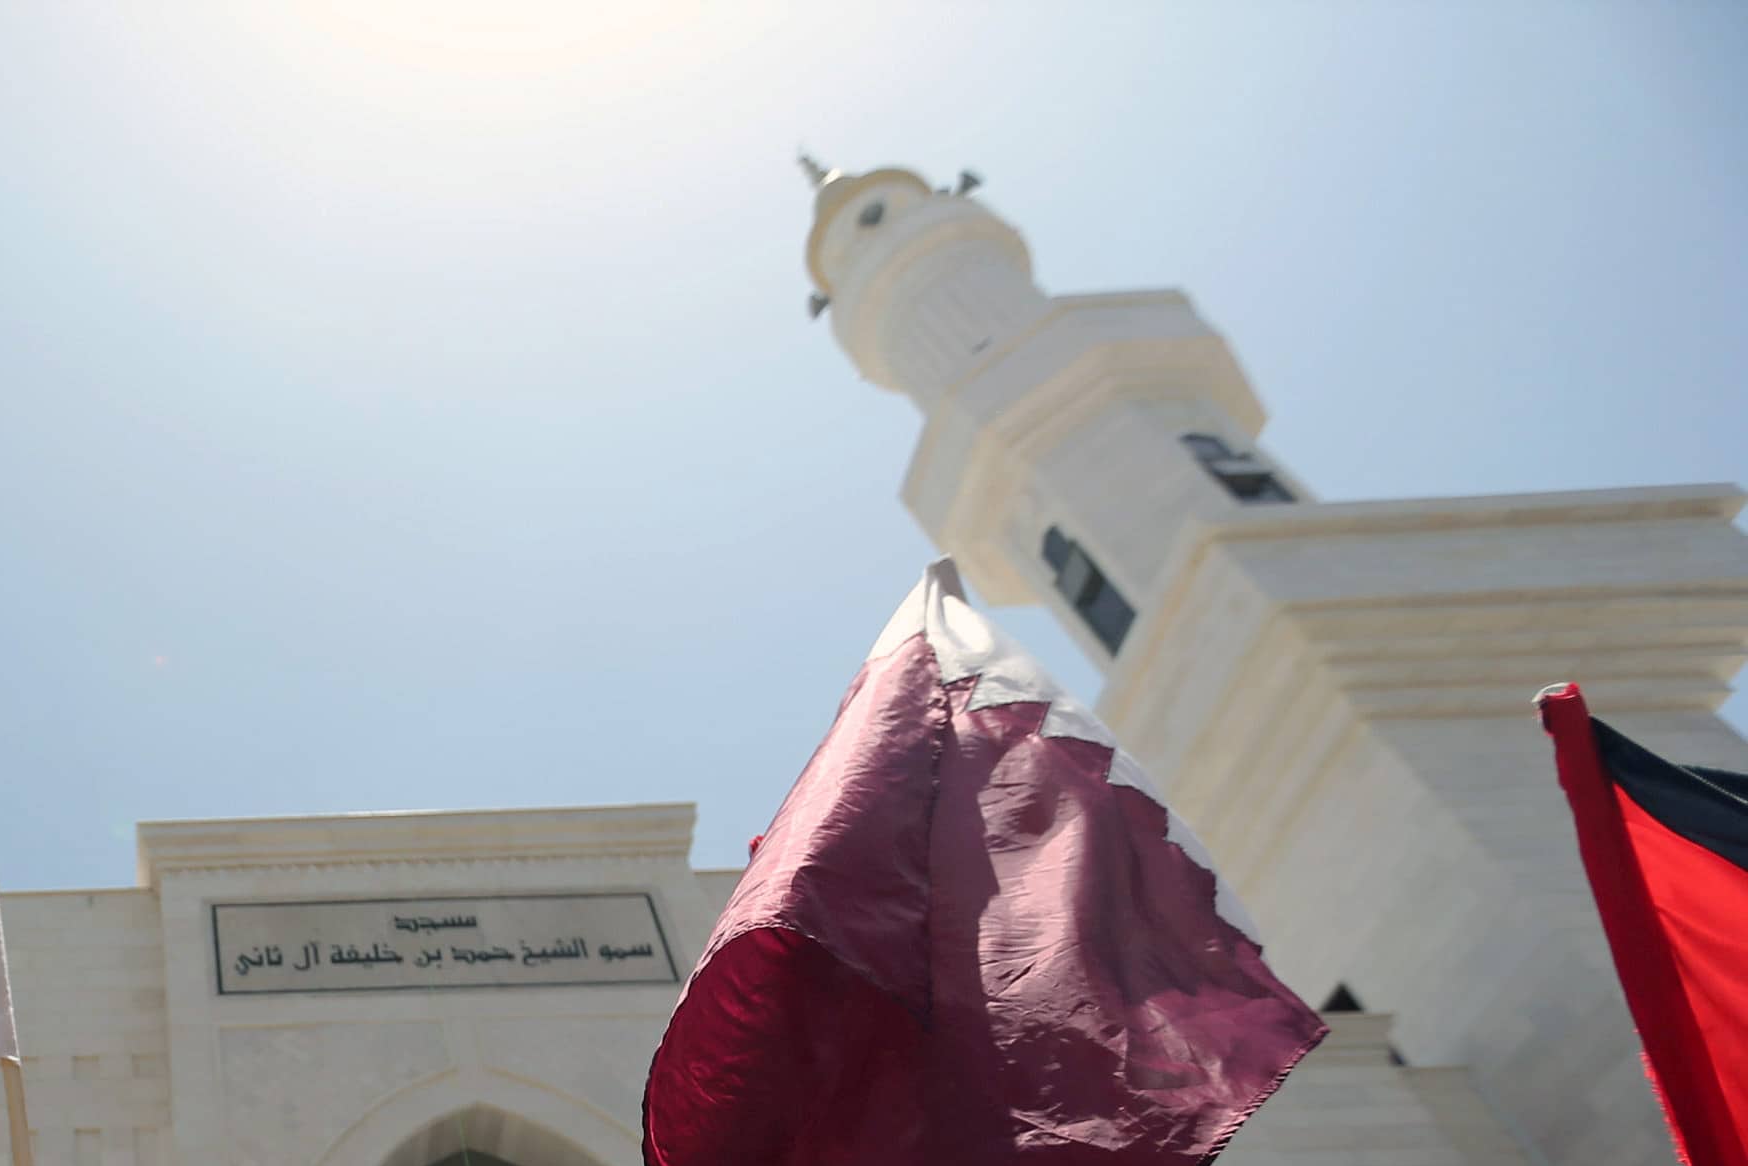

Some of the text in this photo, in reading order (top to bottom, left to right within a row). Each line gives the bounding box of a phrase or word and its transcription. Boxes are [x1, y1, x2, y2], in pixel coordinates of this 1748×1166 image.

[394, 914, 477, 936] مسجد
[331, 942, 403, 966] خليفة
[414, 947, 442, 968] بن
[451, 945, 515, 964] حمد
[520, 937, 588, 966] الشيخ
[599, 943, 653, 962] سمو
